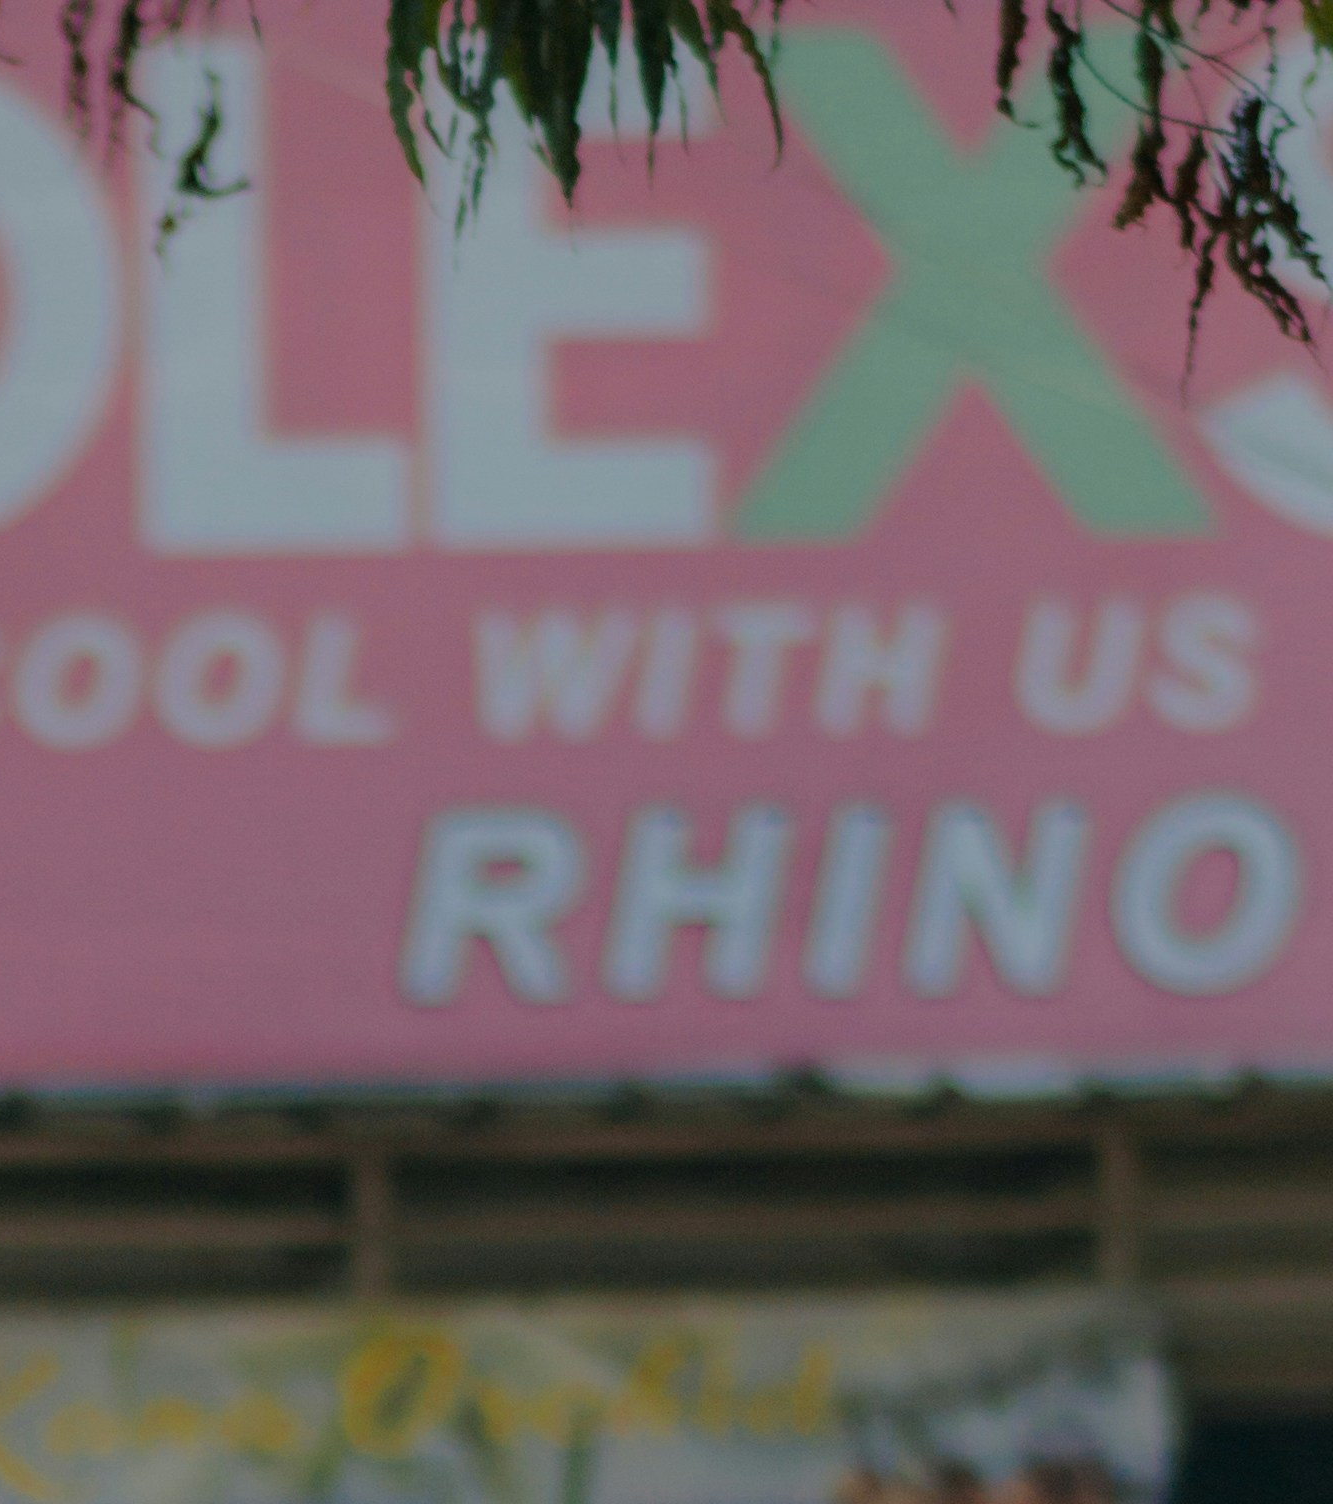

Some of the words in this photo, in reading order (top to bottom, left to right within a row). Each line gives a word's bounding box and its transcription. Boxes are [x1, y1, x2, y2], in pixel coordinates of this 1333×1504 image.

[473, 604, 941, 742] WITH
[1014, 592, 1261, 737] US
[398, 788, 1301, 1005] RHINO
